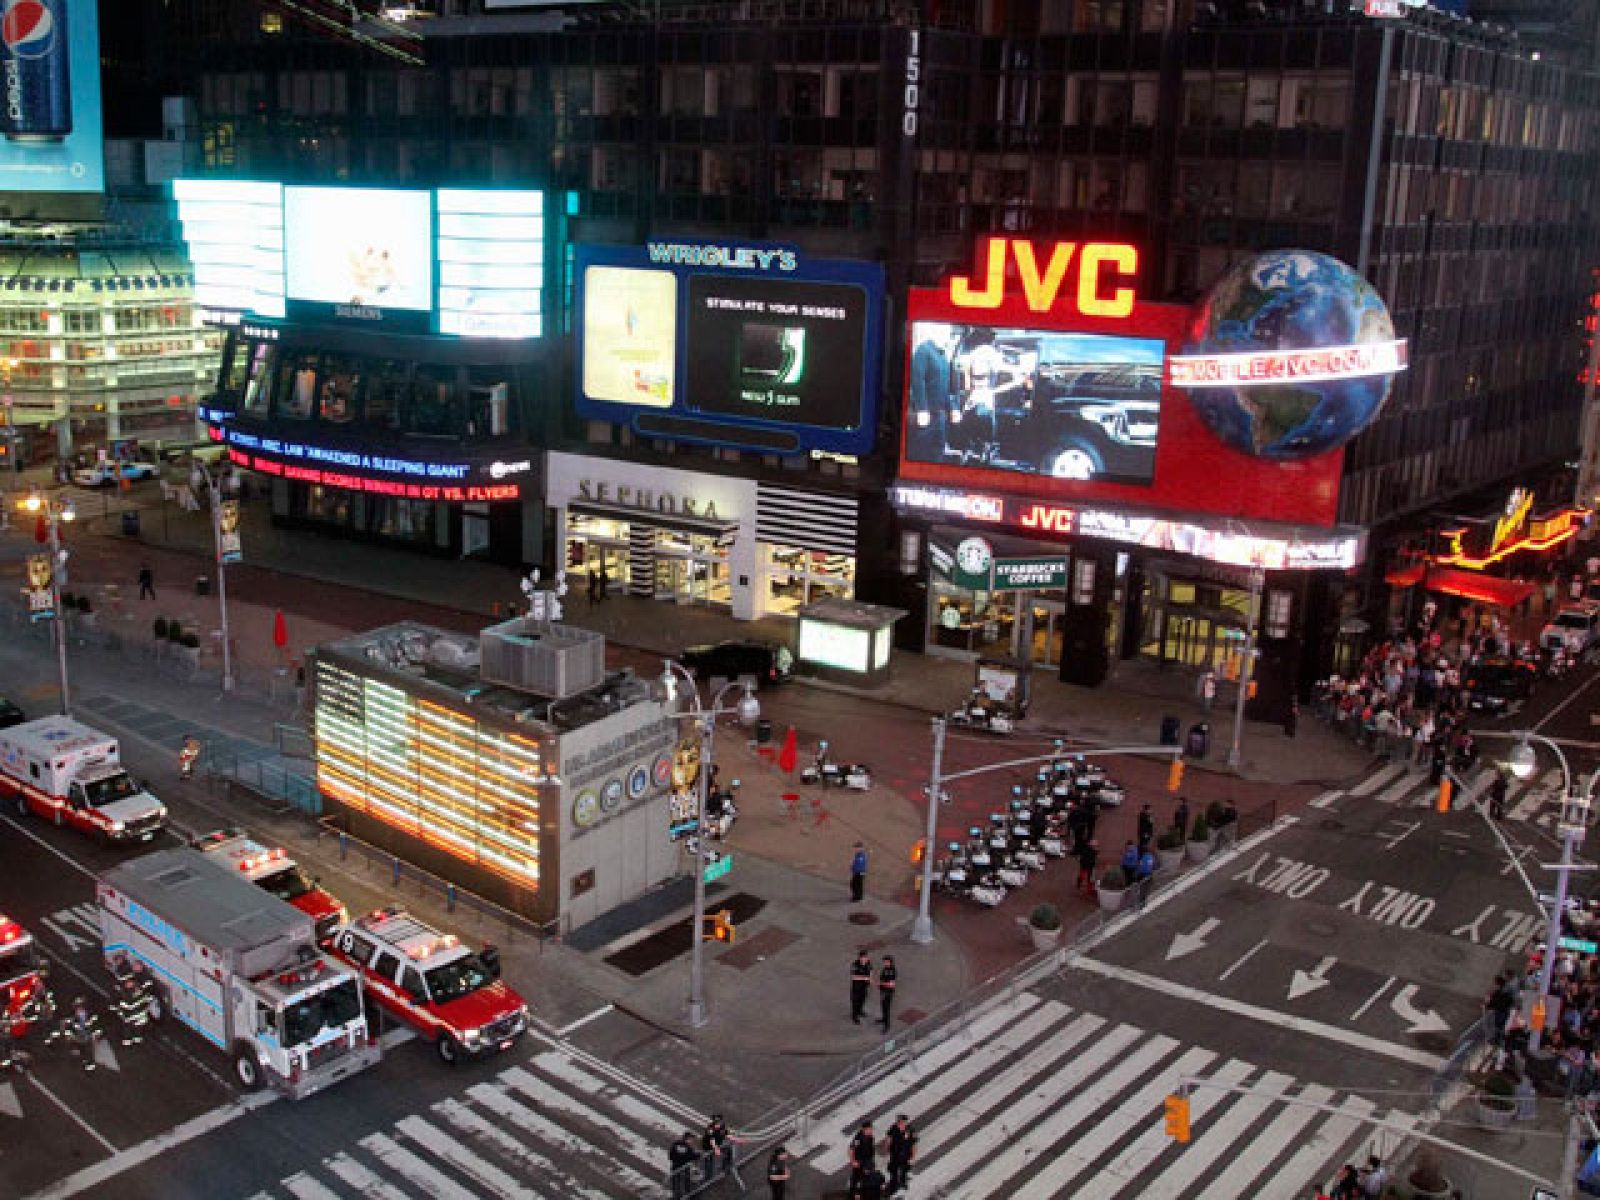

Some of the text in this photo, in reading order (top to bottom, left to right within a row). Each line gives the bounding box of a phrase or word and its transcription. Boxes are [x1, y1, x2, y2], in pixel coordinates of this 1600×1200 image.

[903, 30, 920, 136] 1500
[647, 242, 797, 271] WRIGLEY'S
[950, 237, 1138, 318] JVC
[705, 297, 846, 320] STIMULATE YOUR SENSES
[579, 480, 719, 521] SEPHORA
[1021, 506, 1074, 532] JVC
[996, 562, 1066, 575] STARBUCKS
[1008, 573, 1053, 584] COFFEE
[1232, 852, 1331, 899] ONLY
[1337, 880, 1436, 929] ONLY
